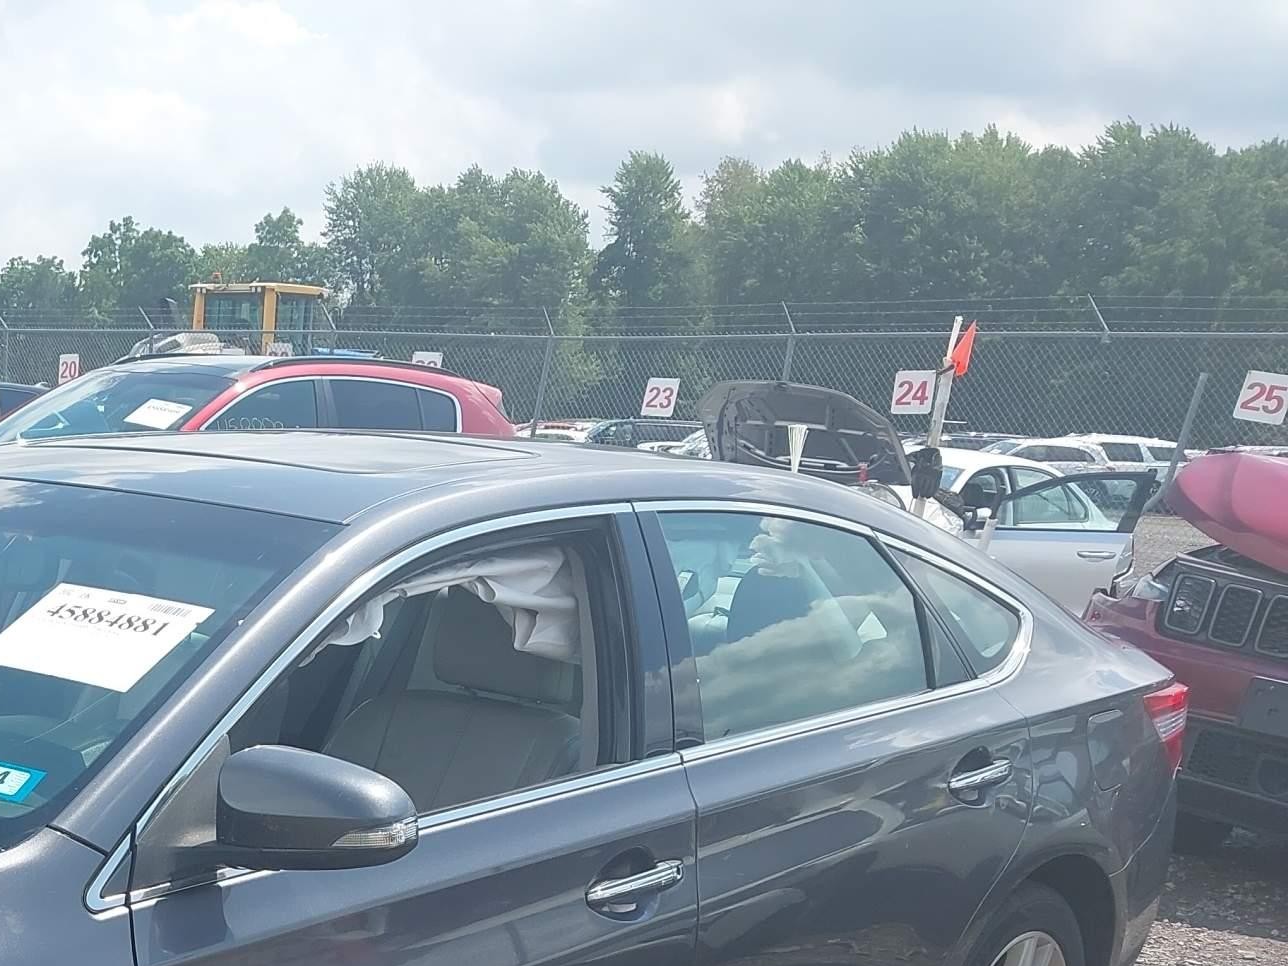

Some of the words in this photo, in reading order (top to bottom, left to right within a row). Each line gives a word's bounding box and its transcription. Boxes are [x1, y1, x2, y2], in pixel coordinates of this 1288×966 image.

[61, 360, 77, 379] 20
[645, 386, 675, 409] 23
[895, 380, 929, 406] 24
[1239, 381, 1288, 415] 25
[46, 603, 171, 637] 45884881
